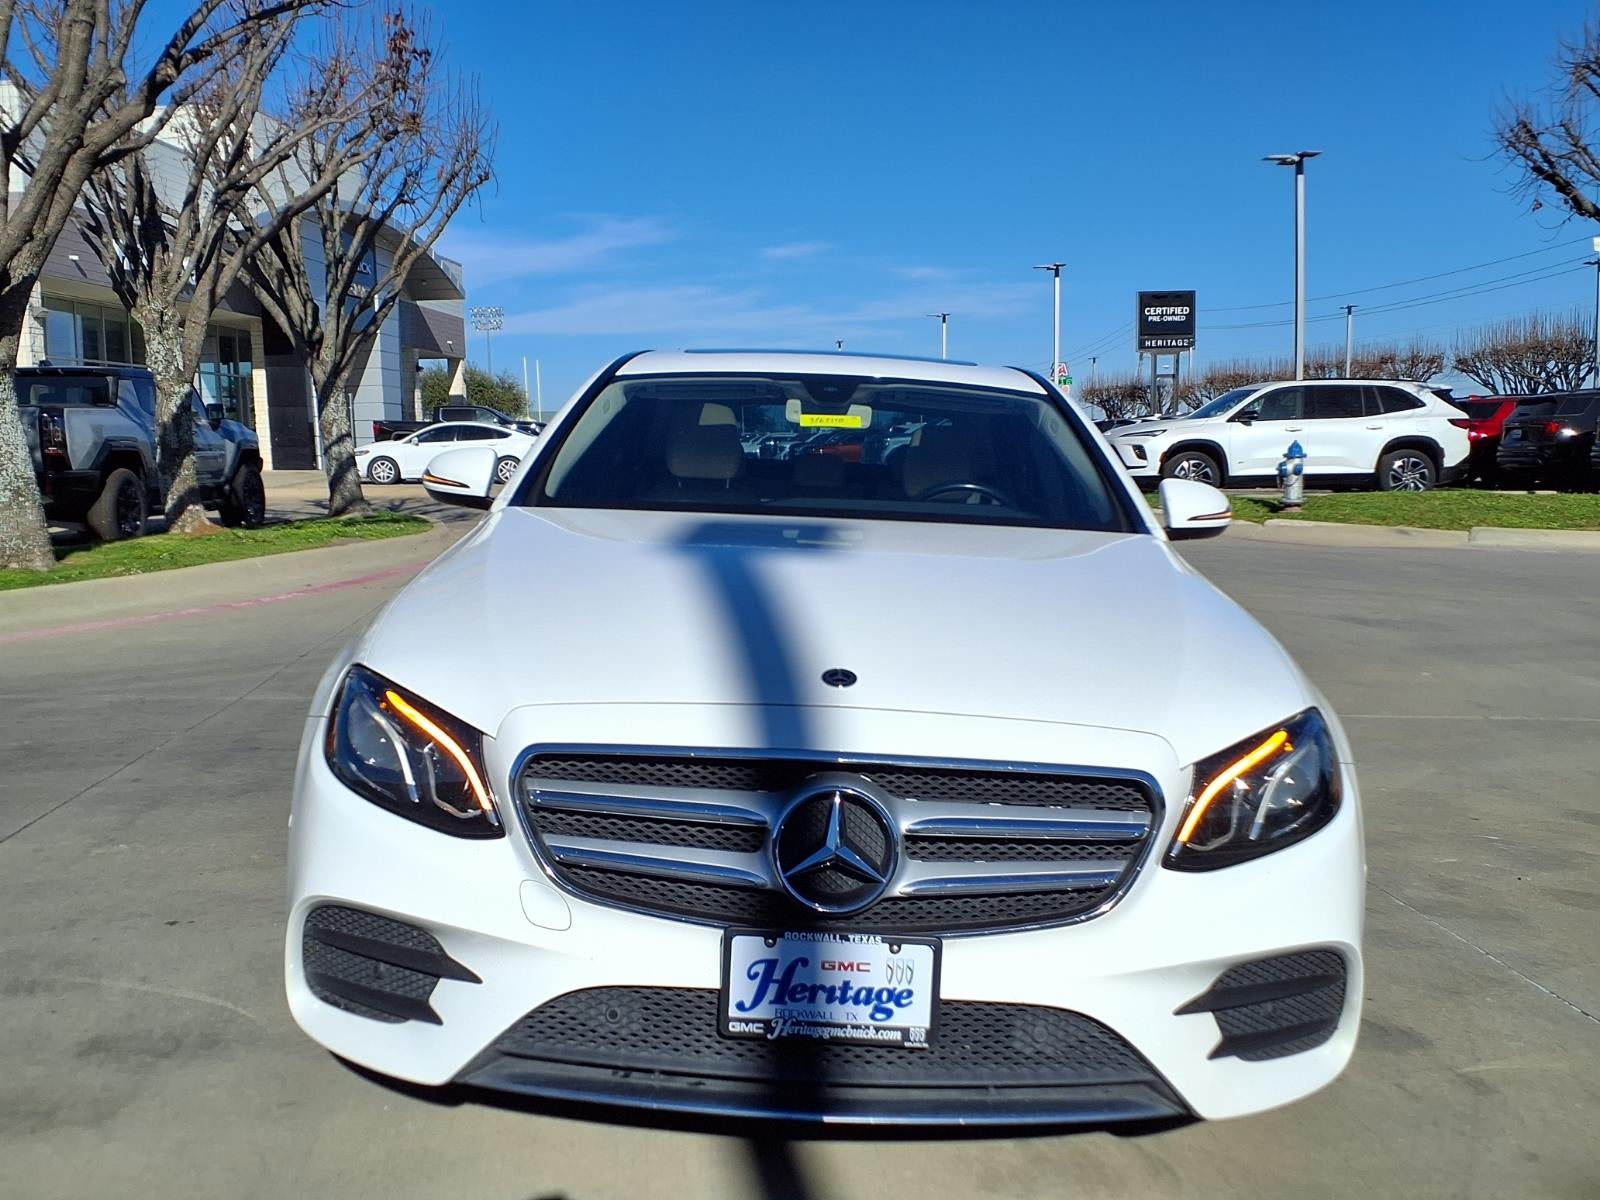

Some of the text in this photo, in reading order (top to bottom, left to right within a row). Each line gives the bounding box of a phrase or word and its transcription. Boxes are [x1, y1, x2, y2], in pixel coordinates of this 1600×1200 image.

[1144, 306, 1190, 315] CERTIFIED
[784, 931, 883, 945] ROCKWALL, TEXAS
[820, 959, 871, 973] GMC
[735, 956, 914, 1022] Heritage
[729, 1021, 764, 1034] GMC
[767, 1018, 902, 1041] Heritagegmcbuick.com
